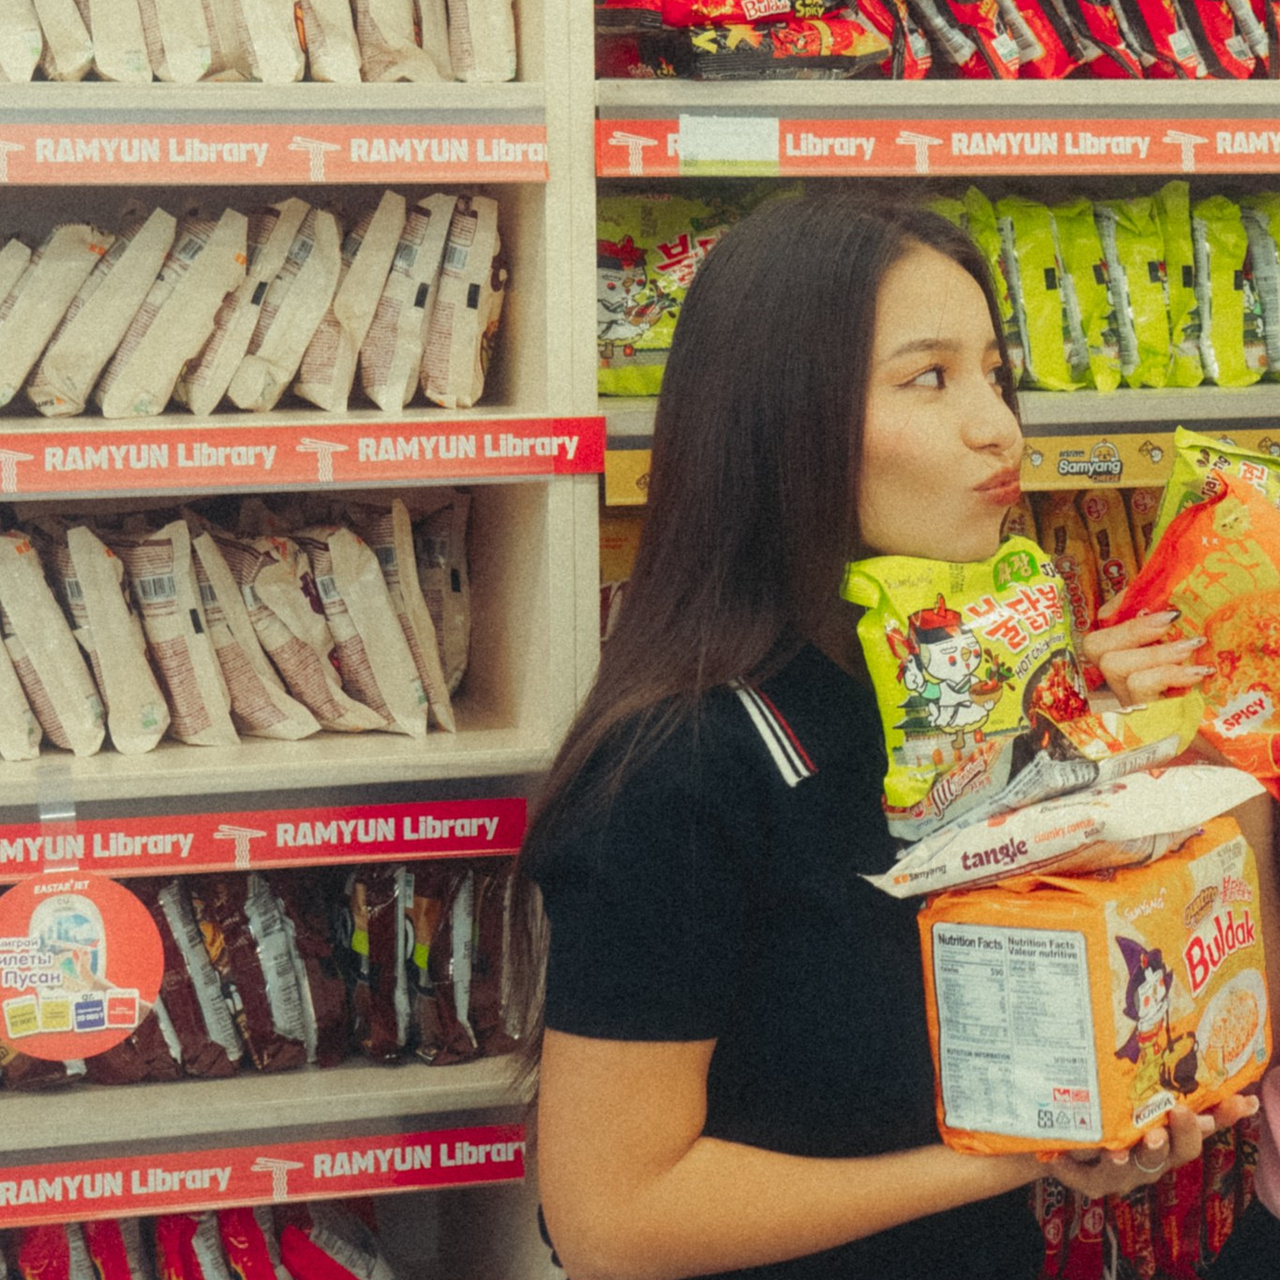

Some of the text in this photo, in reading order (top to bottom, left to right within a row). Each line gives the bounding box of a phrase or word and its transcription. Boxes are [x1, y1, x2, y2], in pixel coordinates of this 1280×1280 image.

[36, 138, 268, 166] RAMYUN Library
[350, 139, 469, 162] RAMYUN
[786, 133, 876, 160] Library
[952, 132, 1150, 158] RAMYUN Library
[45, 443, 276, 471] RAMYUN Library
[358, 433, 578, 462] RAMYUN Library
[1058, 459, 1121, 476] Samyang
[1014, 653, 1034, 681] HOT
[1222, 697, 1267, 732] SPICY
[276, 816, 498, 847] RAMYUN Library
[0, 833, 193, 863] MYUN Library
[961, 836, 1029, 872] tangle
[74, 879, 91, 891] JET
[908, 862, 947, 883] Samyang
[938, 933, 1003, 951] Nutrition Facts
[1008, 936, 1076, 950] Nutrition Facts
[1008, 947, 1079, 960] Valeur nutritive
[1184, 909, 1256, 994] Buldak
[4, 970, 61, 988] Пусан
[312, 1142, 526, 1179] RAMYUN Library
[0, 1167, 232, 1206] RAMYUN Library
